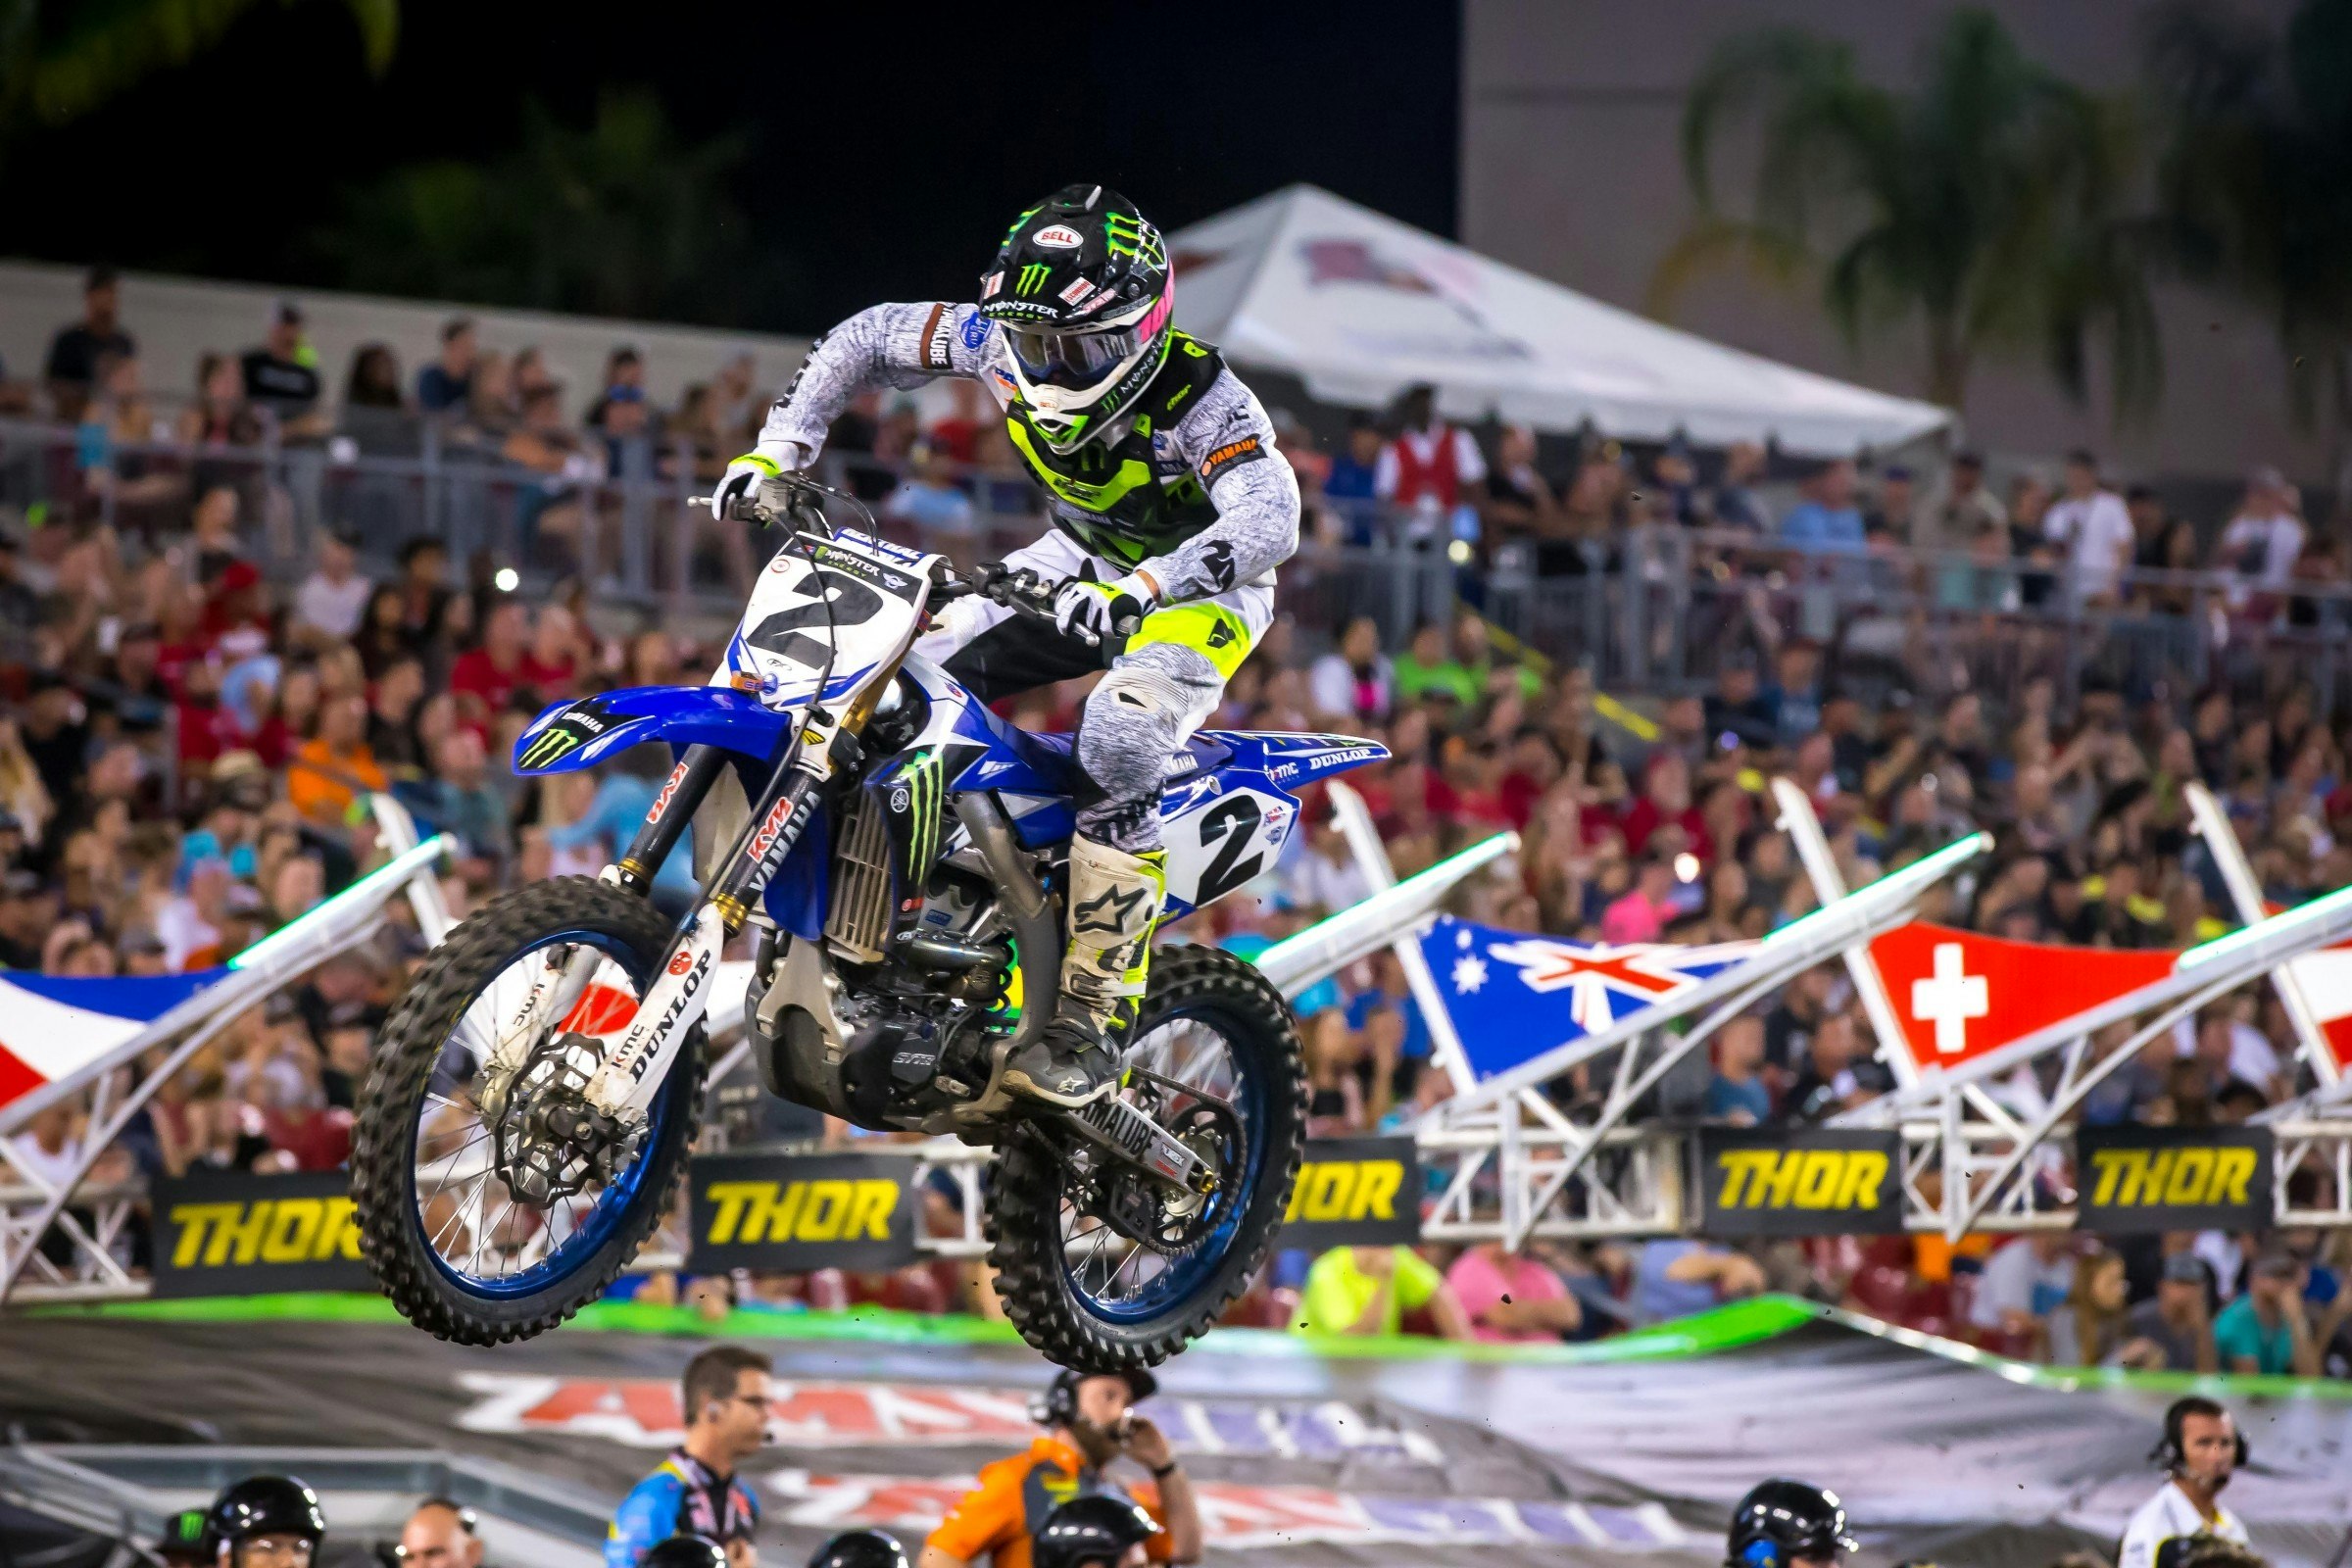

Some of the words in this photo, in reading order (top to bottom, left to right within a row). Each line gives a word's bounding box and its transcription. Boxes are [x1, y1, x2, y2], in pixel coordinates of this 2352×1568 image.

[1042, 230, 1073, 244] BELL
[982, 300, 1058, 318] MONSTER
[989, 311, 1045, 320] ENERGY
[1209, 439, 1257, 465] YAMAHA
[746, 570, 884, 671] 2
[562, 711, 605, 733] YAMAHA
[1309, 749, 1371, 769] DUNLOP
[748, 790, 822, 895] YAMAHA
[1195, 794, 1265, 907] 2
[628, 949, 711, 1085] DUNLOP
[1718, 1150, 1889, 1210] THOR
[2091, 1146, 2258, 1207] THOR
[707, 1179, 900, 1245] THOR
